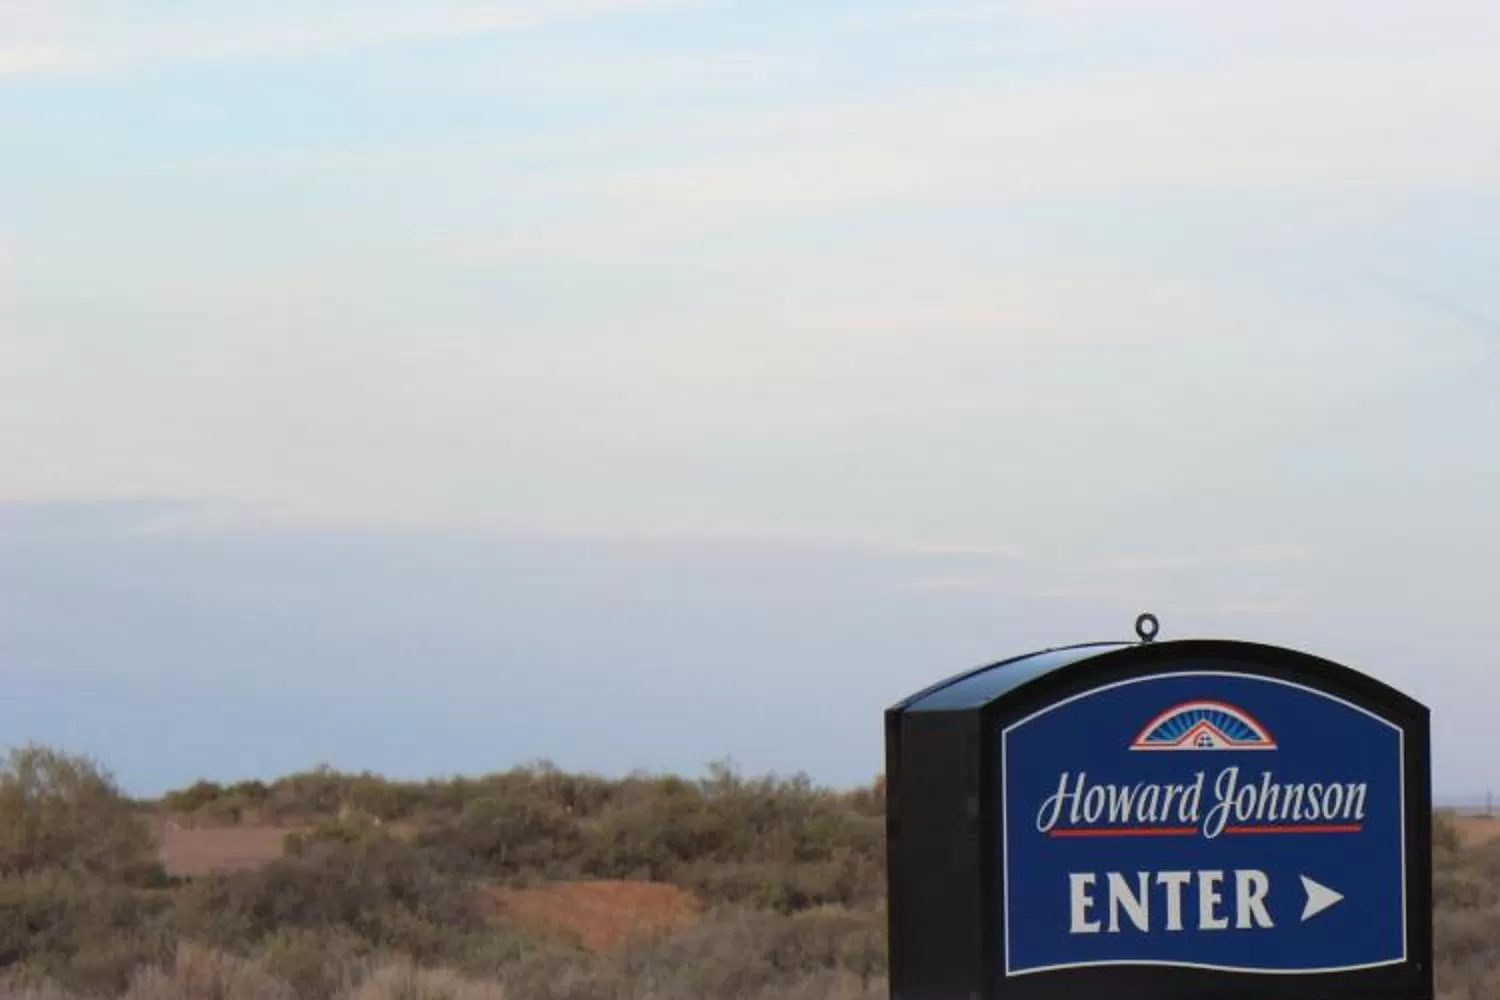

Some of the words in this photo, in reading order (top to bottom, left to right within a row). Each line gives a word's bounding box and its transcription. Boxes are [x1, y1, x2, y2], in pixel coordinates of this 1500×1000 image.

[1036, 771, 1205, 833] Howard
[1202, 765, 1368, 839] Johnson
[1068, 868, 1276, 934] ENTER
